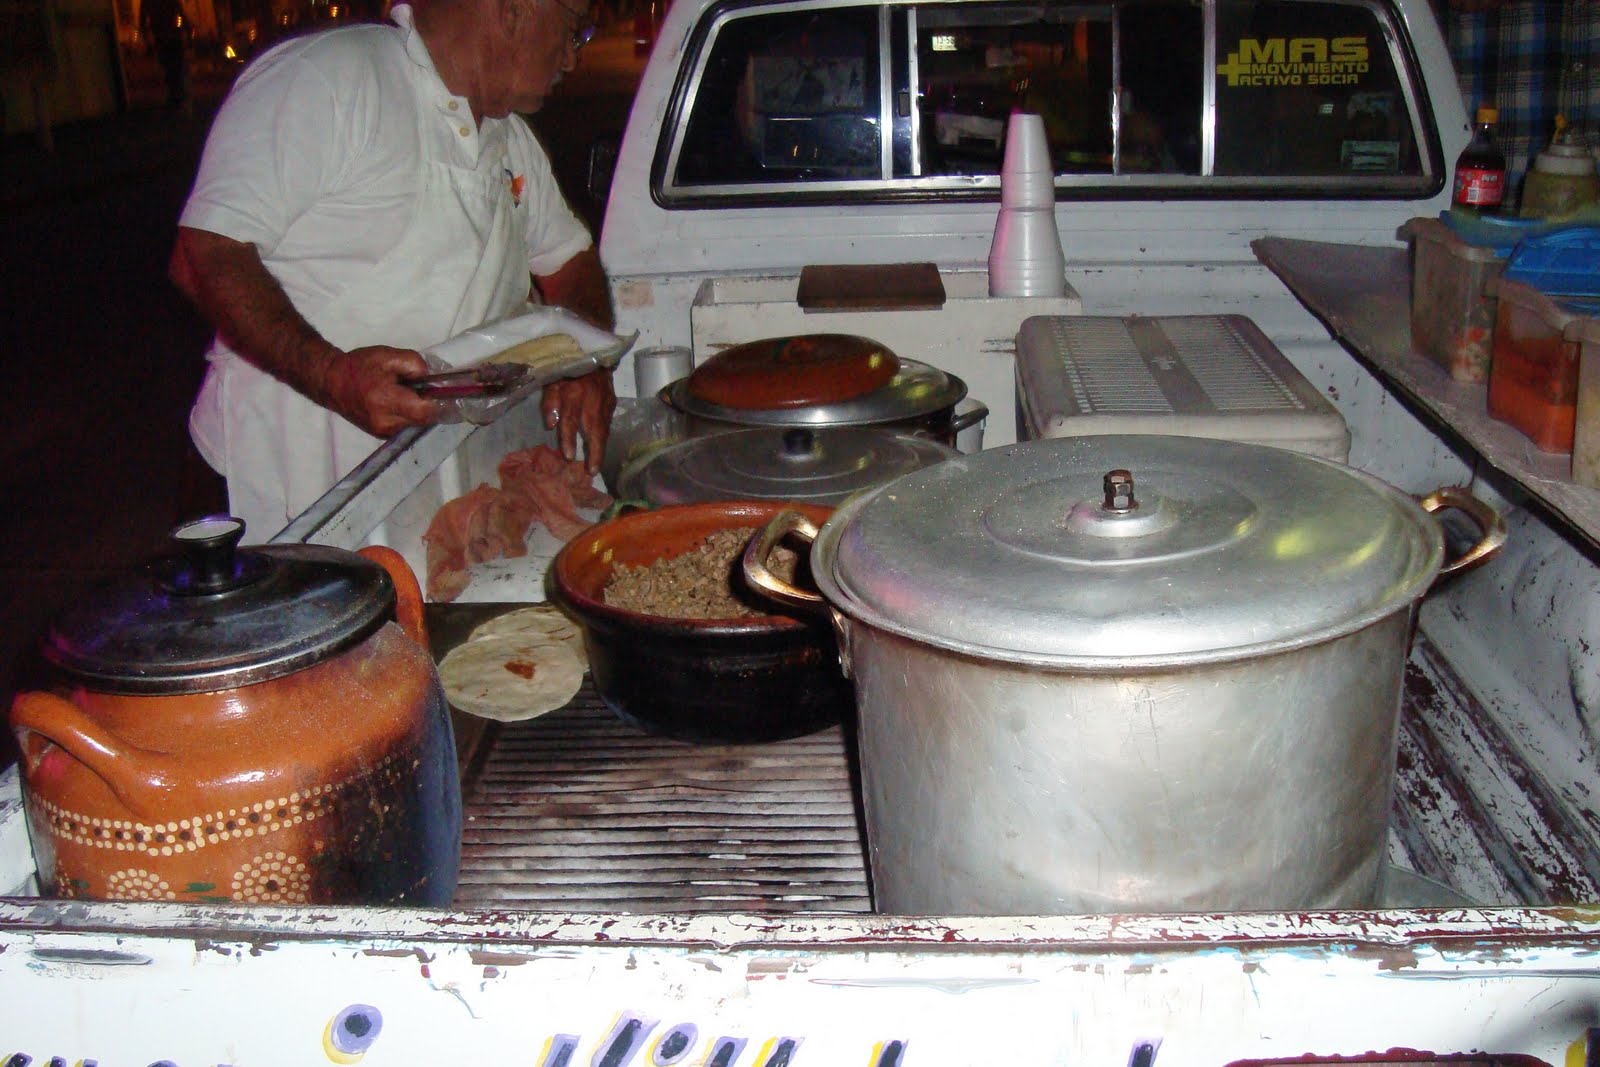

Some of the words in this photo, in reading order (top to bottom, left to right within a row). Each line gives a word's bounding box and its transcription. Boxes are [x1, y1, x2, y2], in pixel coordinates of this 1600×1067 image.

[1239, 37, 1369, 63] MAS
[1251, 63, 1369, 74] MOVIMIENTO
[1240, 74, 1300, 86] ACTIVO
